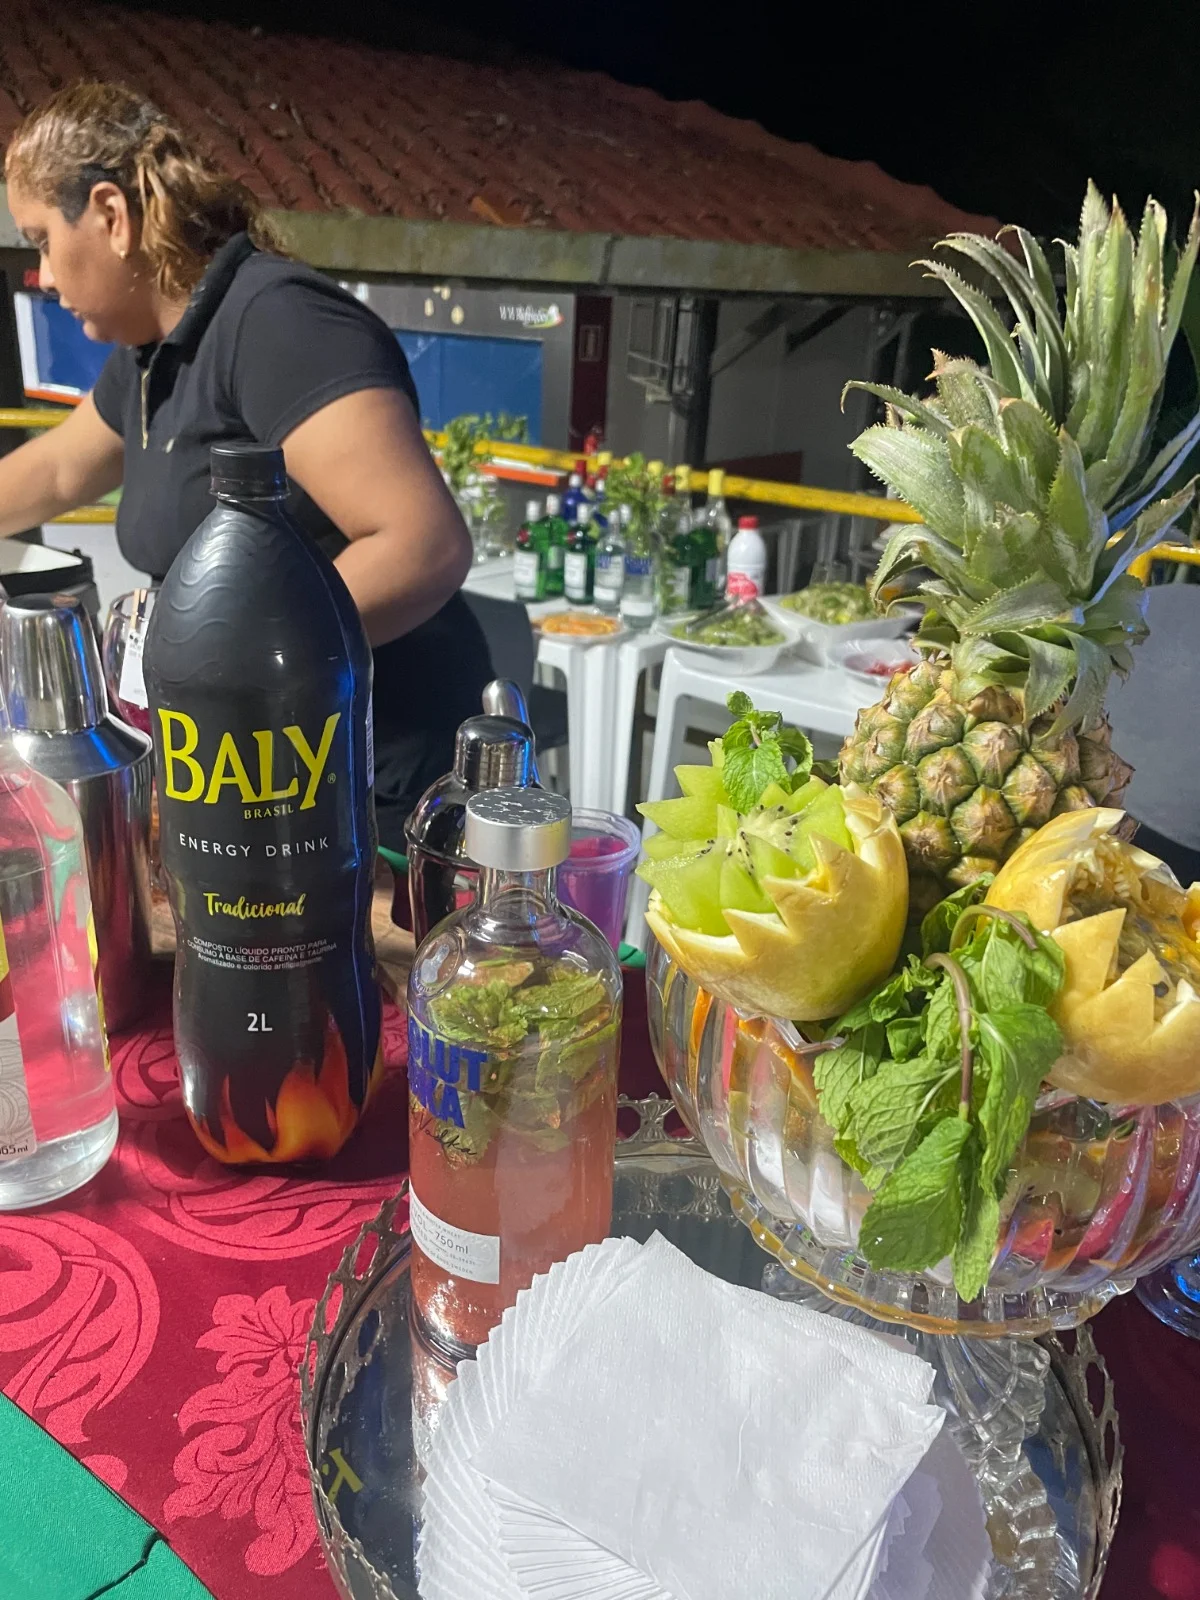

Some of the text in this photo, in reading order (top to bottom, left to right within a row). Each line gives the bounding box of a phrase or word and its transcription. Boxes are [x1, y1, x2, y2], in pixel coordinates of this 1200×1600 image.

[158, 708, 341, 810] BALY
[244, 804, 294, 819] BRASIL
[179, 833, 329, 857] ENERGY DRINK
[203, 892, 307, 920] Tradicional
[187, 939, 217, 957] CONSUMO
[225, 953, 247, 962] BASE
[248, 955, 260, 963] DE
[307, 941, 337, 957] TAURINA
[193, 936, 327, 956] COMPOSTO LÍQUIDO PRONTO PARA
[197, 952, 235, 968] Aromatizado
[243, 962, 272, 970] colorido
[247, 1012, 273, 1032] 2L
[0, 1144, 28, 1155] 65 ml
[455, 1244, 469, 1255] ml
